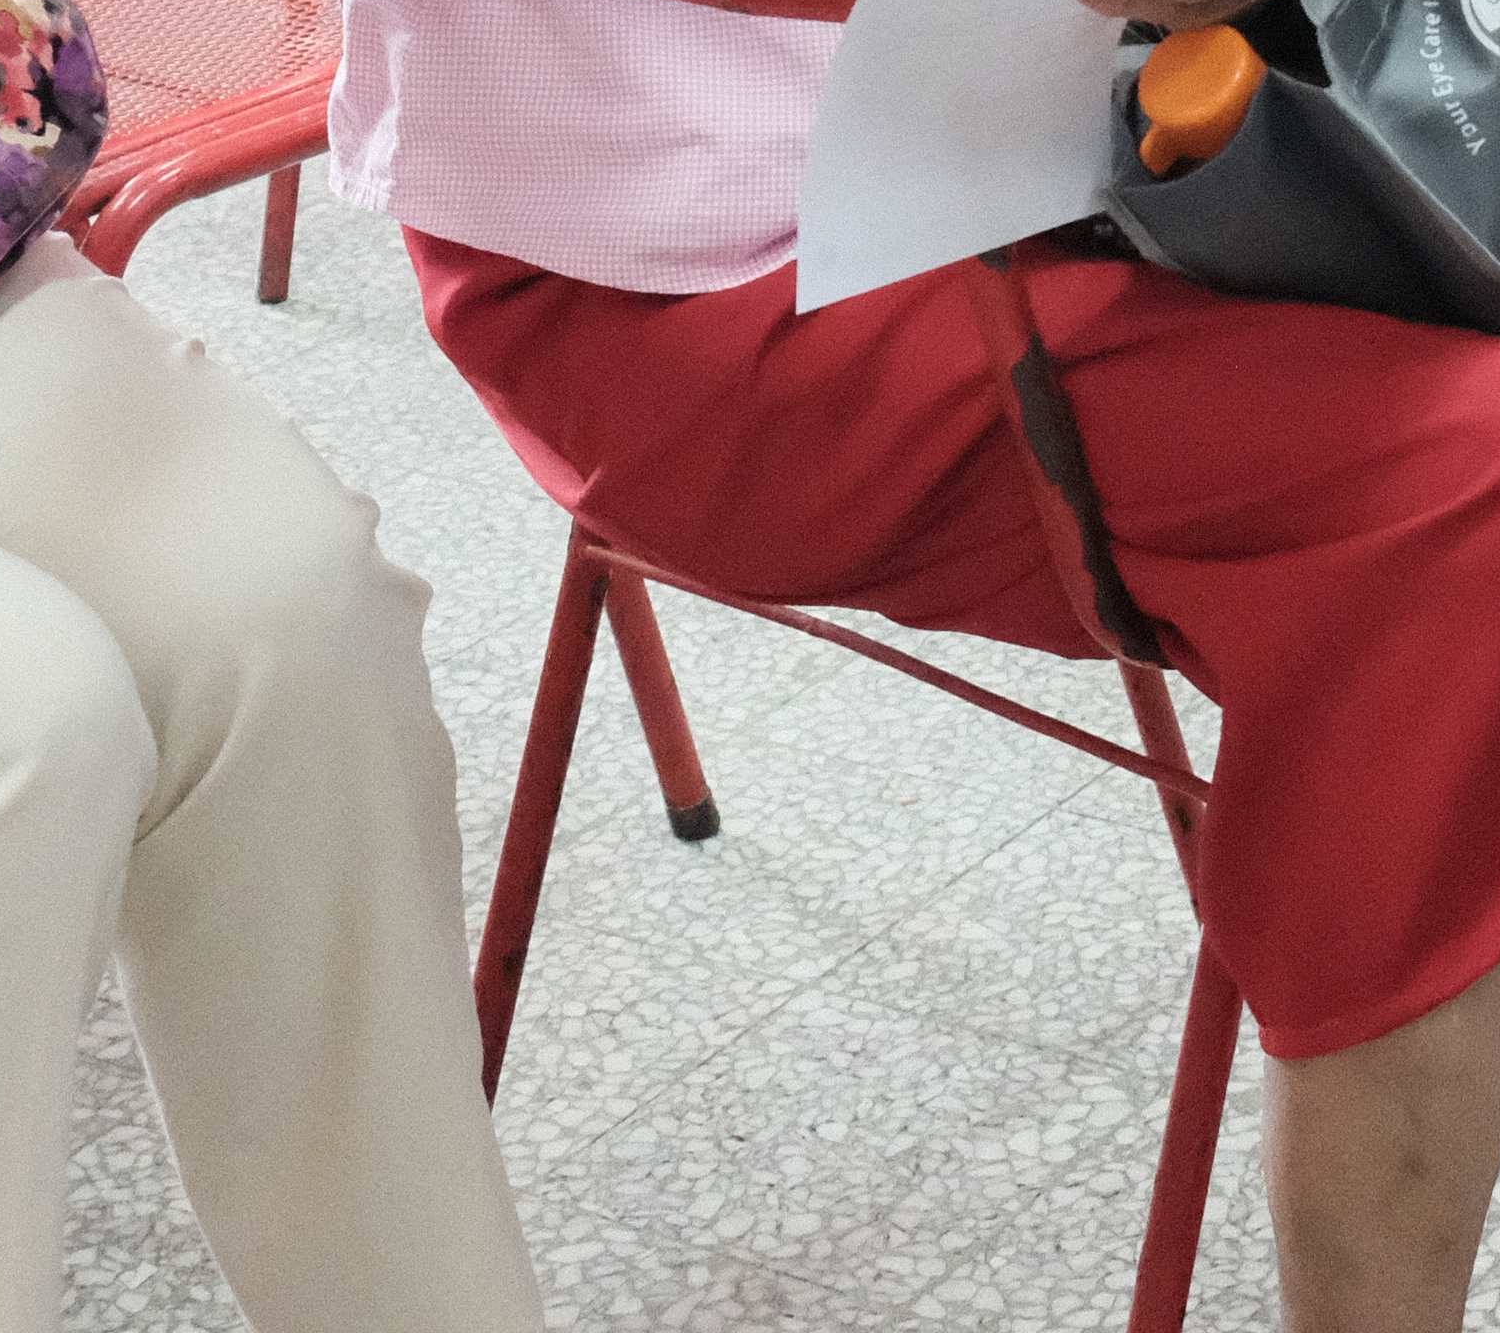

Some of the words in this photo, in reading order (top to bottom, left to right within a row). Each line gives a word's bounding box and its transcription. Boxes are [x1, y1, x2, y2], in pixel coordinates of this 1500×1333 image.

[1419, 13, 1443, 60] Care
[1431, 60, 1456, 99] Eye
[1445, 100, 1487, 156] Your
